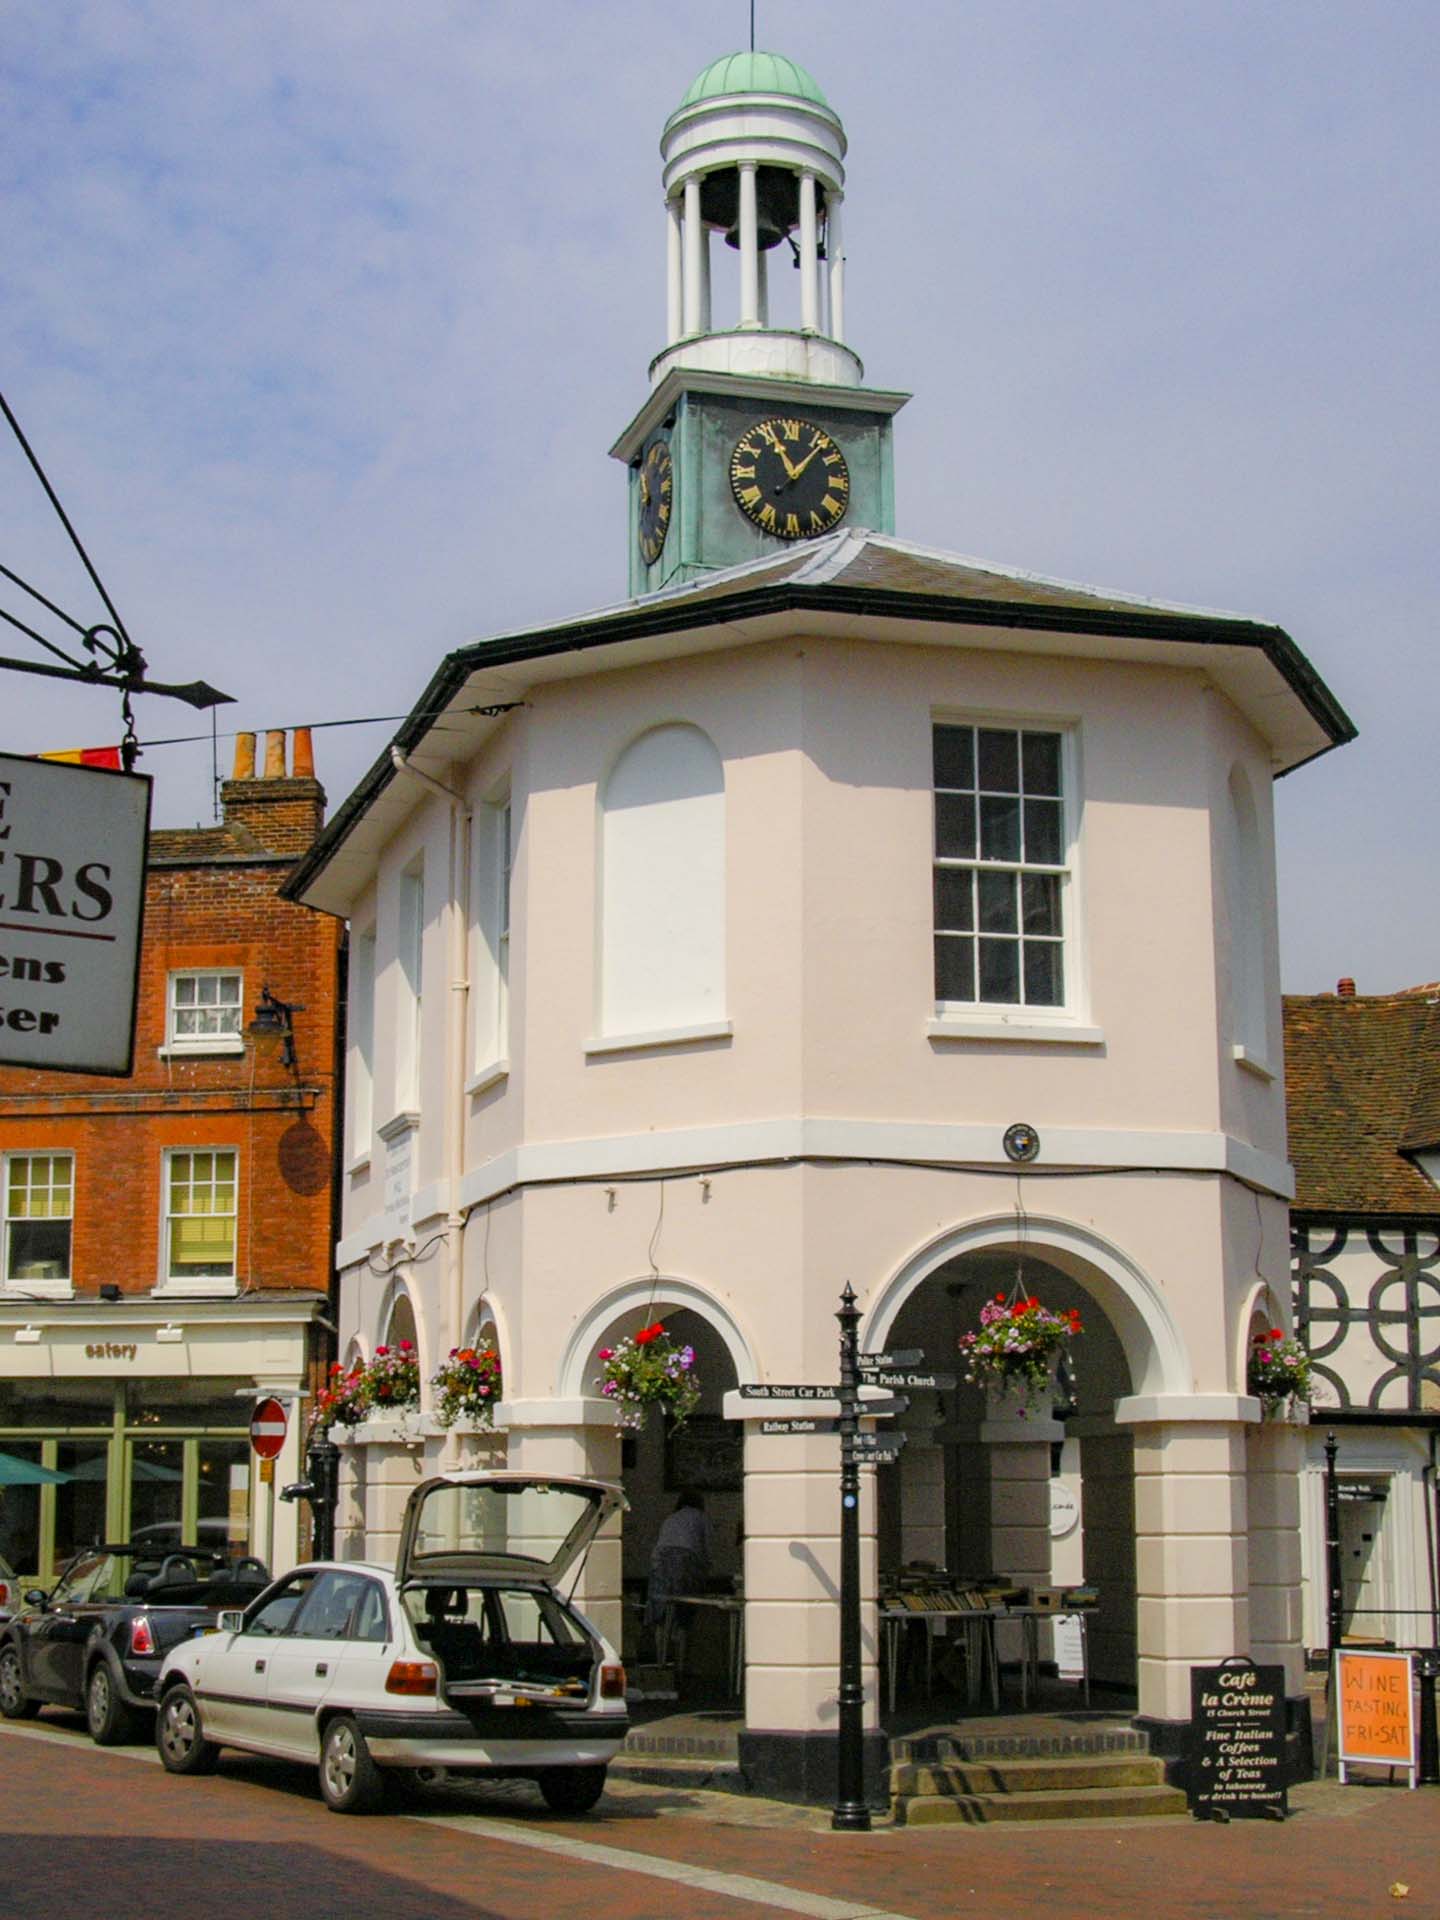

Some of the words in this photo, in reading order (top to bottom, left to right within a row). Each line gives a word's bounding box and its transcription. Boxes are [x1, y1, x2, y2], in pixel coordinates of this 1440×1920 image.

[0, 852, 114, 922] RS
[0, 1005, 60, 1036] er
[85, 1341, 137, 1362] eatery
[862, 1372, 877, 1384] The
[879, 1373, 905, 1385] Parish
[907, 1375, 936, 1387] Church
[745, 1386, 769, 1397] South
[771, 1386, 796, 1398] Street
[798, 1387, 815, 1398] Car
[816, 1387, 836, 1398] Park
[790, 1420, 816, 1431] Station
[1218, 1672, 1257, 1690] Café
[1344, 1666, 1402, 1694] WINE
[1201, 1692, 1219, 1708] la
[1221, 1692, 1275, 1707] Crème
[1217, 1709, 1246, 1717] Church
[1247, 1708, 1272, 1717] Street
[1205, 1730, 1232, 1741] Fine
[1234, 1729, 1274, 1741] Italian
[1218, 1742, 1261, 1755] Coffees
[1201, 1756, 1213, 1768] &
[1215, 1756, 1226, 1767] A
[1227, 1756, 1279, 1767] Selection
[1218, 1768, 1233, 1782] of
[1235, 1768, 1263, 1779] Teas
[1213, 1782, 1224, 1791] to
[1198, 1793, 1210, 1801] or
[1211, 1791, 1237, 1801] drink
